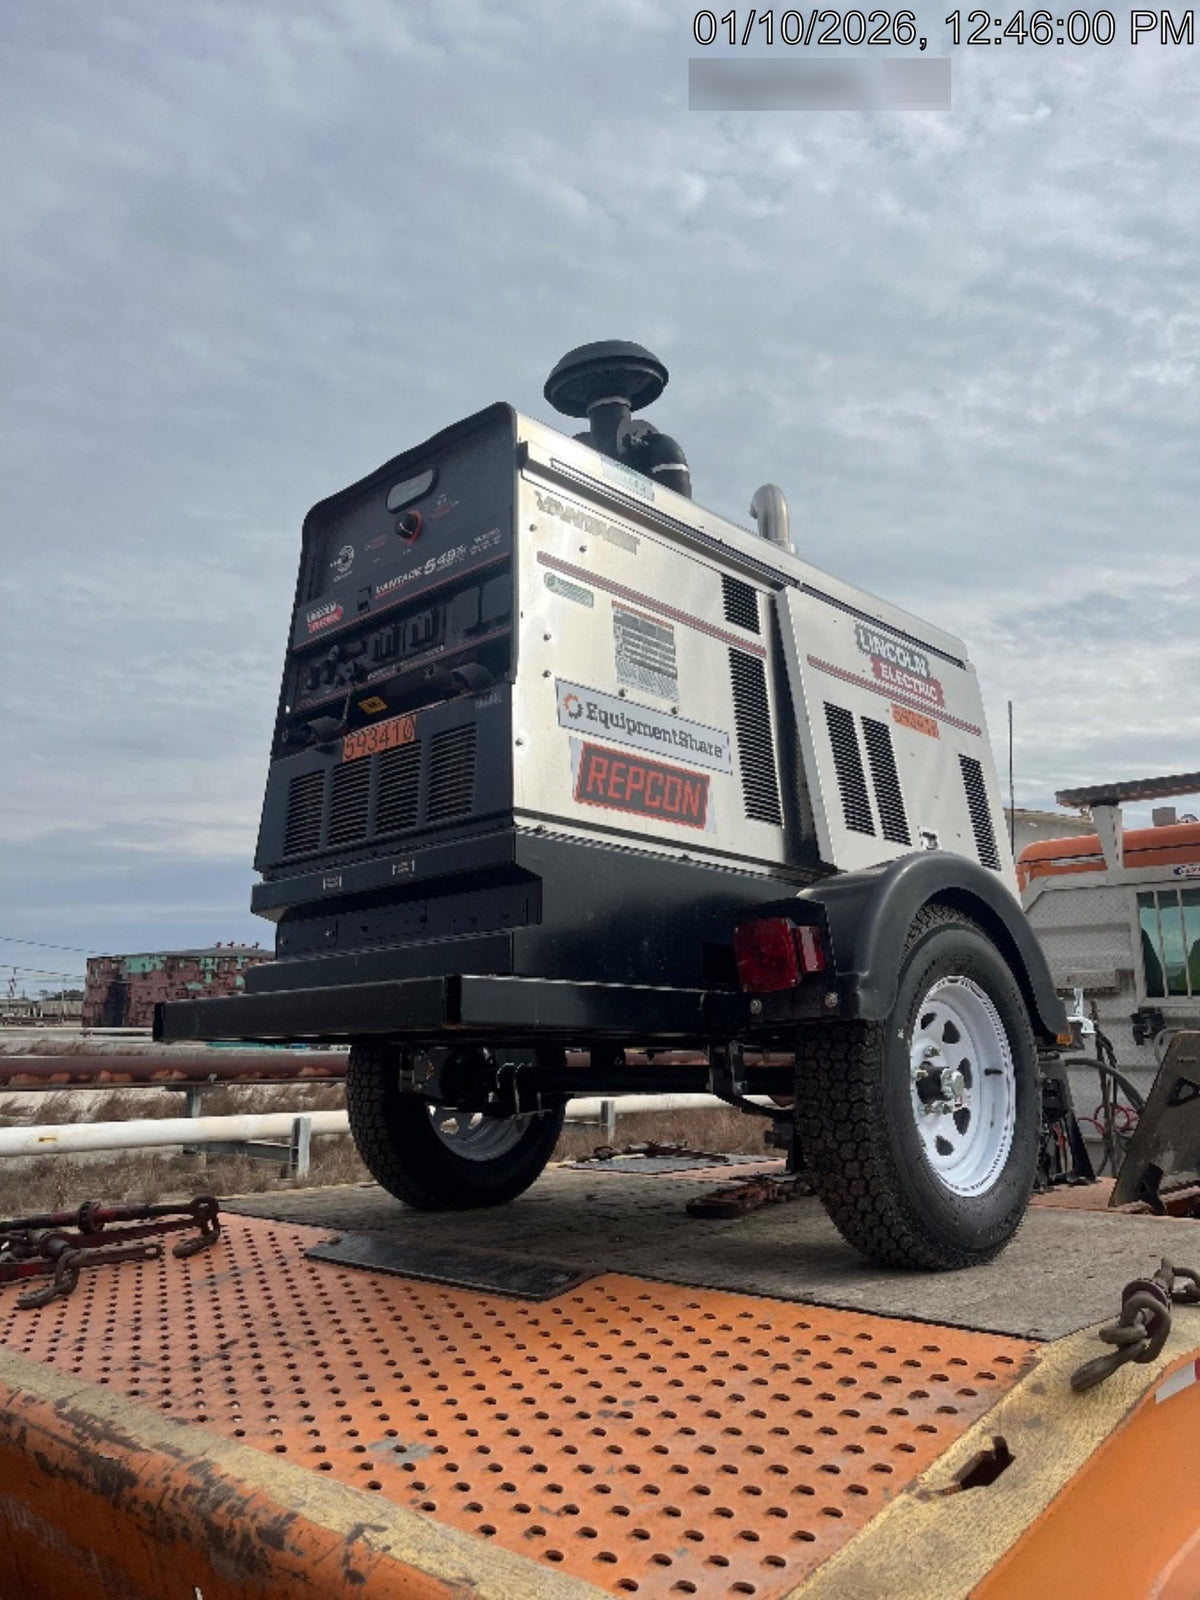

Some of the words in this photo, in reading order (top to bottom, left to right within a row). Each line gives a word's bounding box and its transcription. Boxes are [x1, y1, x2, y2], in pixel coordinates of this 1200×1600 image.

[879, 662, 938, 702] ELECTRIC
[586, 701, 724, 759] EquipmentShare
[586, 755, 701, 817] REPCON
